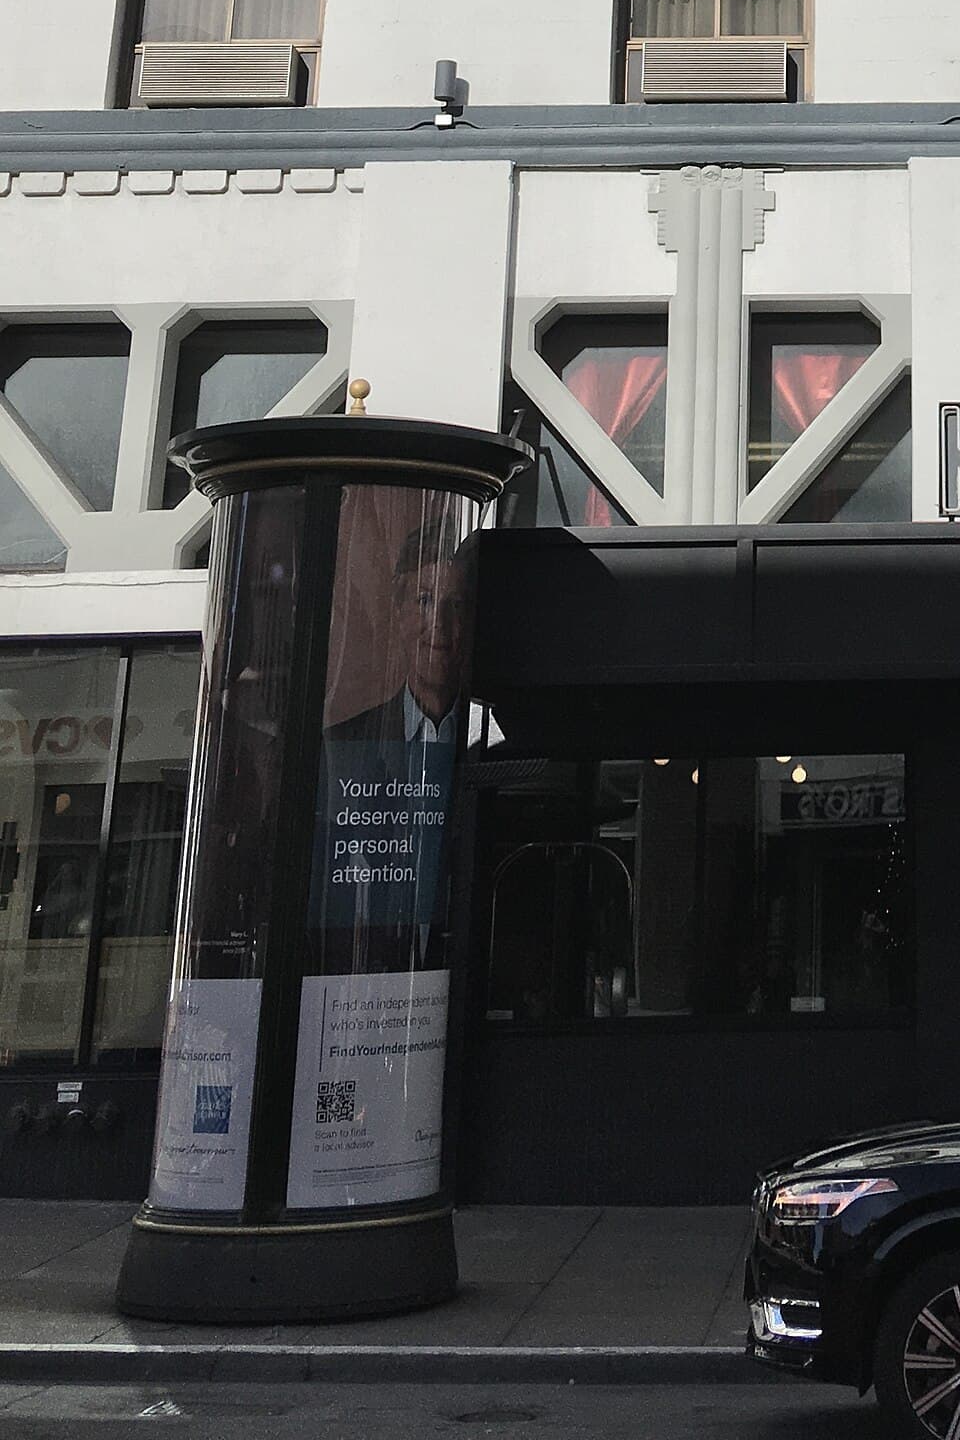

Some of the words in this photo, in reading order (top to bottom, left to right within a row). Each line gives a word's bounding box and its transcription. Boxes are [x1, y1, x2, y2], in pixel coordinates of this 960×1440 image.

[338, 778, 382, 798] Your
[385, 777, 441, 798] dreams
[336, 806, 409, 826] deserve
[413, 810, 446, 826] more
[334, 834, 413, 860] personal
[331, 862, 417, 884] attention.
[332, 998, 357, 1012] Find
[360, 1000, 374, 1011] an
[330, 1017, 364, 1031] who's
[366, 1015, 408, 1030] invested
[314, 1129, 338, 1140] Scan
